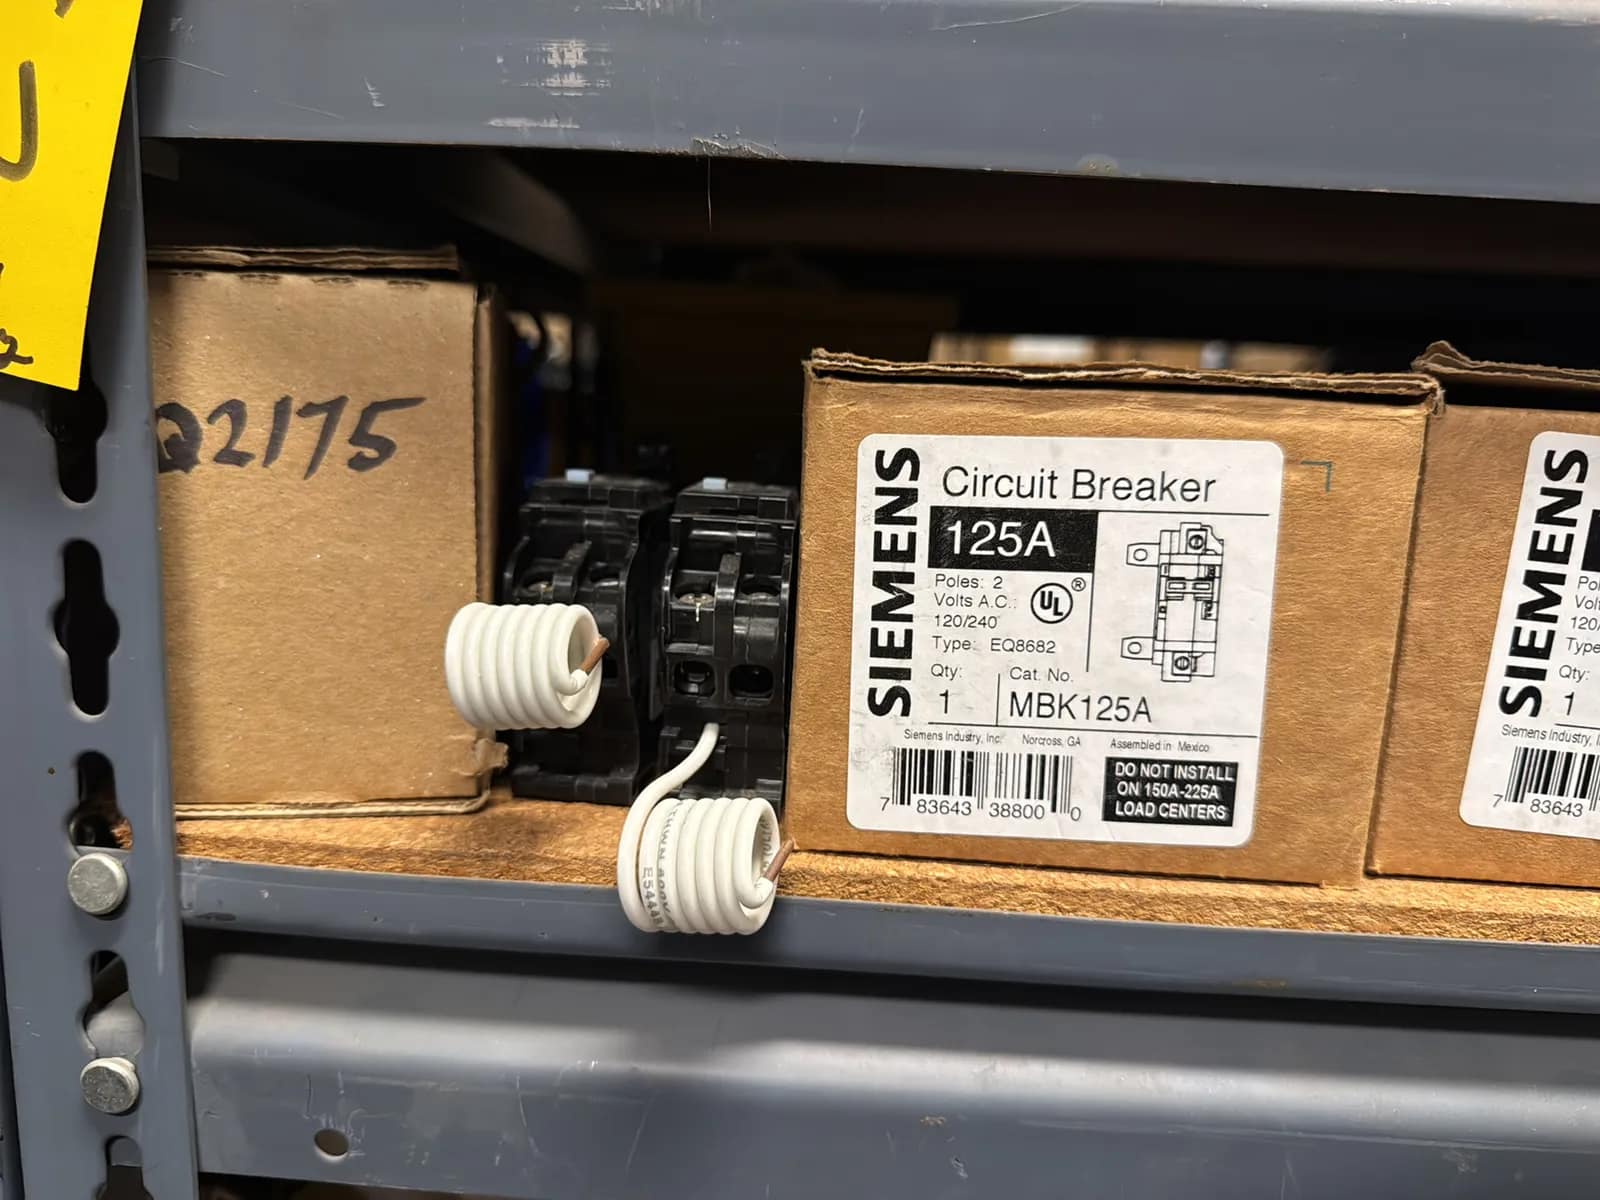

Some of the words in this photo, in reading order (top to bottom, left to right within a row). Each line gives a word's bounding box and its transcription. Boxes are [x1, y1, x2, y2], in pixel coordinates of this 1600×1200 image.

[155, 394, 428, 480] Q2175
[942, 465, 1059, 499] Circuit
[1071, 468, 1217, 502] Breaker
[947, 520, 1057, 558] 125A
[868, 446, 921, 718] SIEMENS
[934, 573, 984, 589] Poles:
[992, 575, 1003, 590] 2
[1498, 448, 1590, 718] SIEMENS
[934, 592, 973, 608] Volts
[934, 614, 998, 629] 120/240
[932, 635, 977, 653] Type:
[990, 637, 1056, 654] EQ8682
[930, 663, 963, 681] Qty:
[1047, 667, 1074, 682] No.
[1559, 664, 1590, 683] Qty:
[939, 689, 949, 714] 1
[1009, 691, 1152, 723] MBK125A
[1564, 691, 1575, 716] 1
[904, 729, 944, 741] Siemens
[1067, 736, 1082, 747] GA
[1501, 724, 1548, 740] Siemens
[1110, 738, 1161, 751] Assembled
[1163, 740, 1172, 751] in
[1177, 741, 1210, 753] Mexico
[1115, 761, 1137, 777] DO
[1140, 763, 1171, 779] NOT
[1173, 765, 1236, 782] INSTALL
[1117, 781, 1140, 797] ON
[1144, 783, 1220, 800] 150A-225A
[880, 796, 890, 811] 7
[916, 798, 973, 816] 83643
[989, 801, 1046, 820] 38800
[1070, 806, 1082, 822] 0
[1115, 800, 1156, 818] LOAD
[1159, 803, 1227, 820] CENTERS
[1493, 793, 1504, 808] 7
[1530, 798, 1584, 818] 83643
